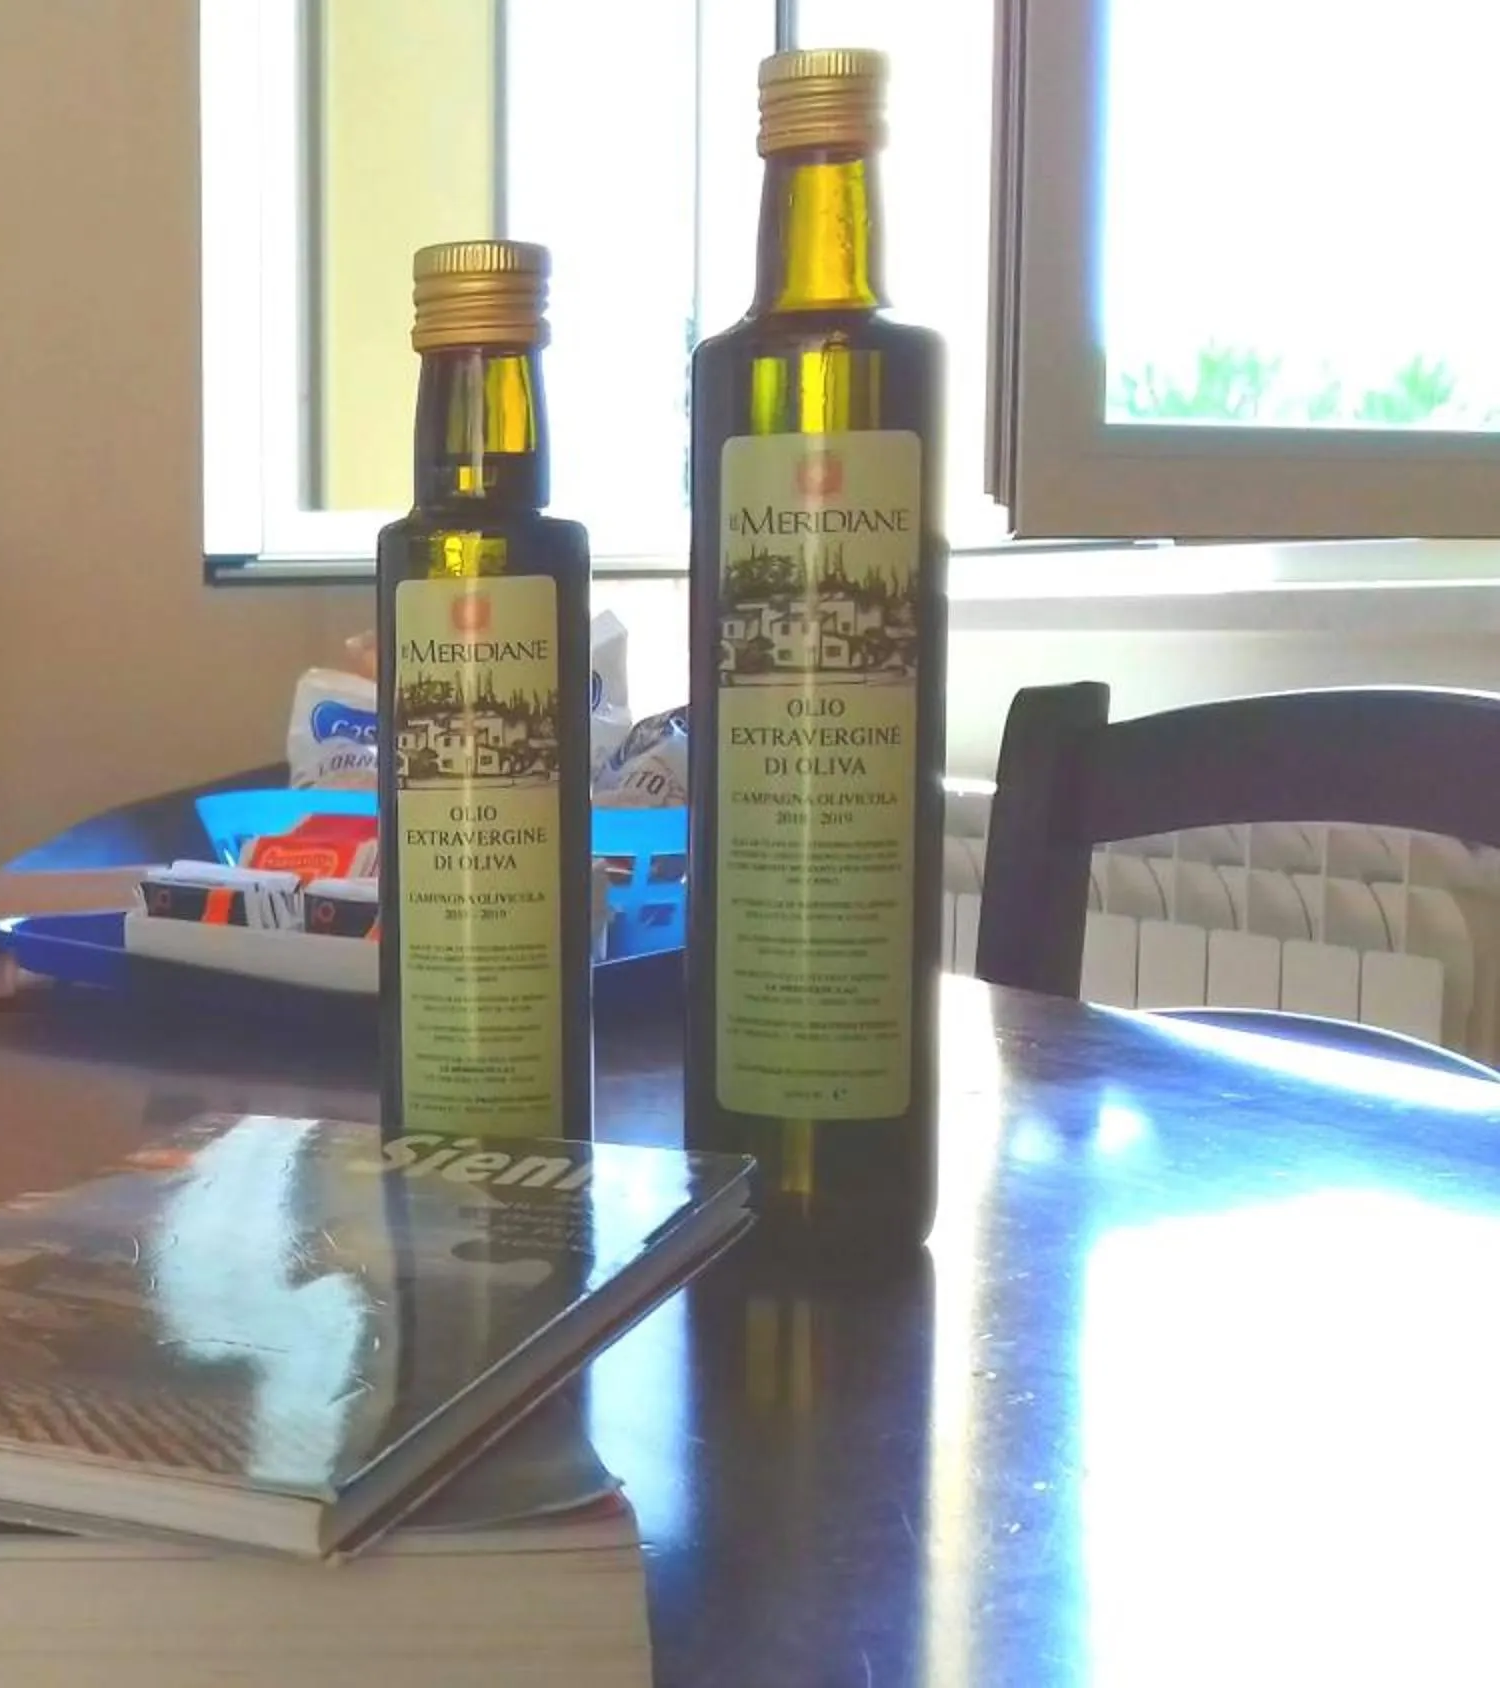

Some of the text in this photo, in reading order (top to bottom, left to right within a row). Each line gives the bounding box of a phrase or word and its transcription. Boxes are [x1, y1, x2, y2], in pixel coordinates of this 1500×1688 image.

[740, 505, 910, 536] MERIDIANE
[410, 639, 549, 664] MERIDIANE
[786, 698, 846, 718] OLIO
[730, 726, 902, 746] EXTRAVERGINE
[764, 757, 867, 776] DI OLIVA
[449, 805, 498, 822] OLIO
[406, 827, 548, 846] EXTRAVERGINE
[434, 853, 518, 871] DI OLIVA
